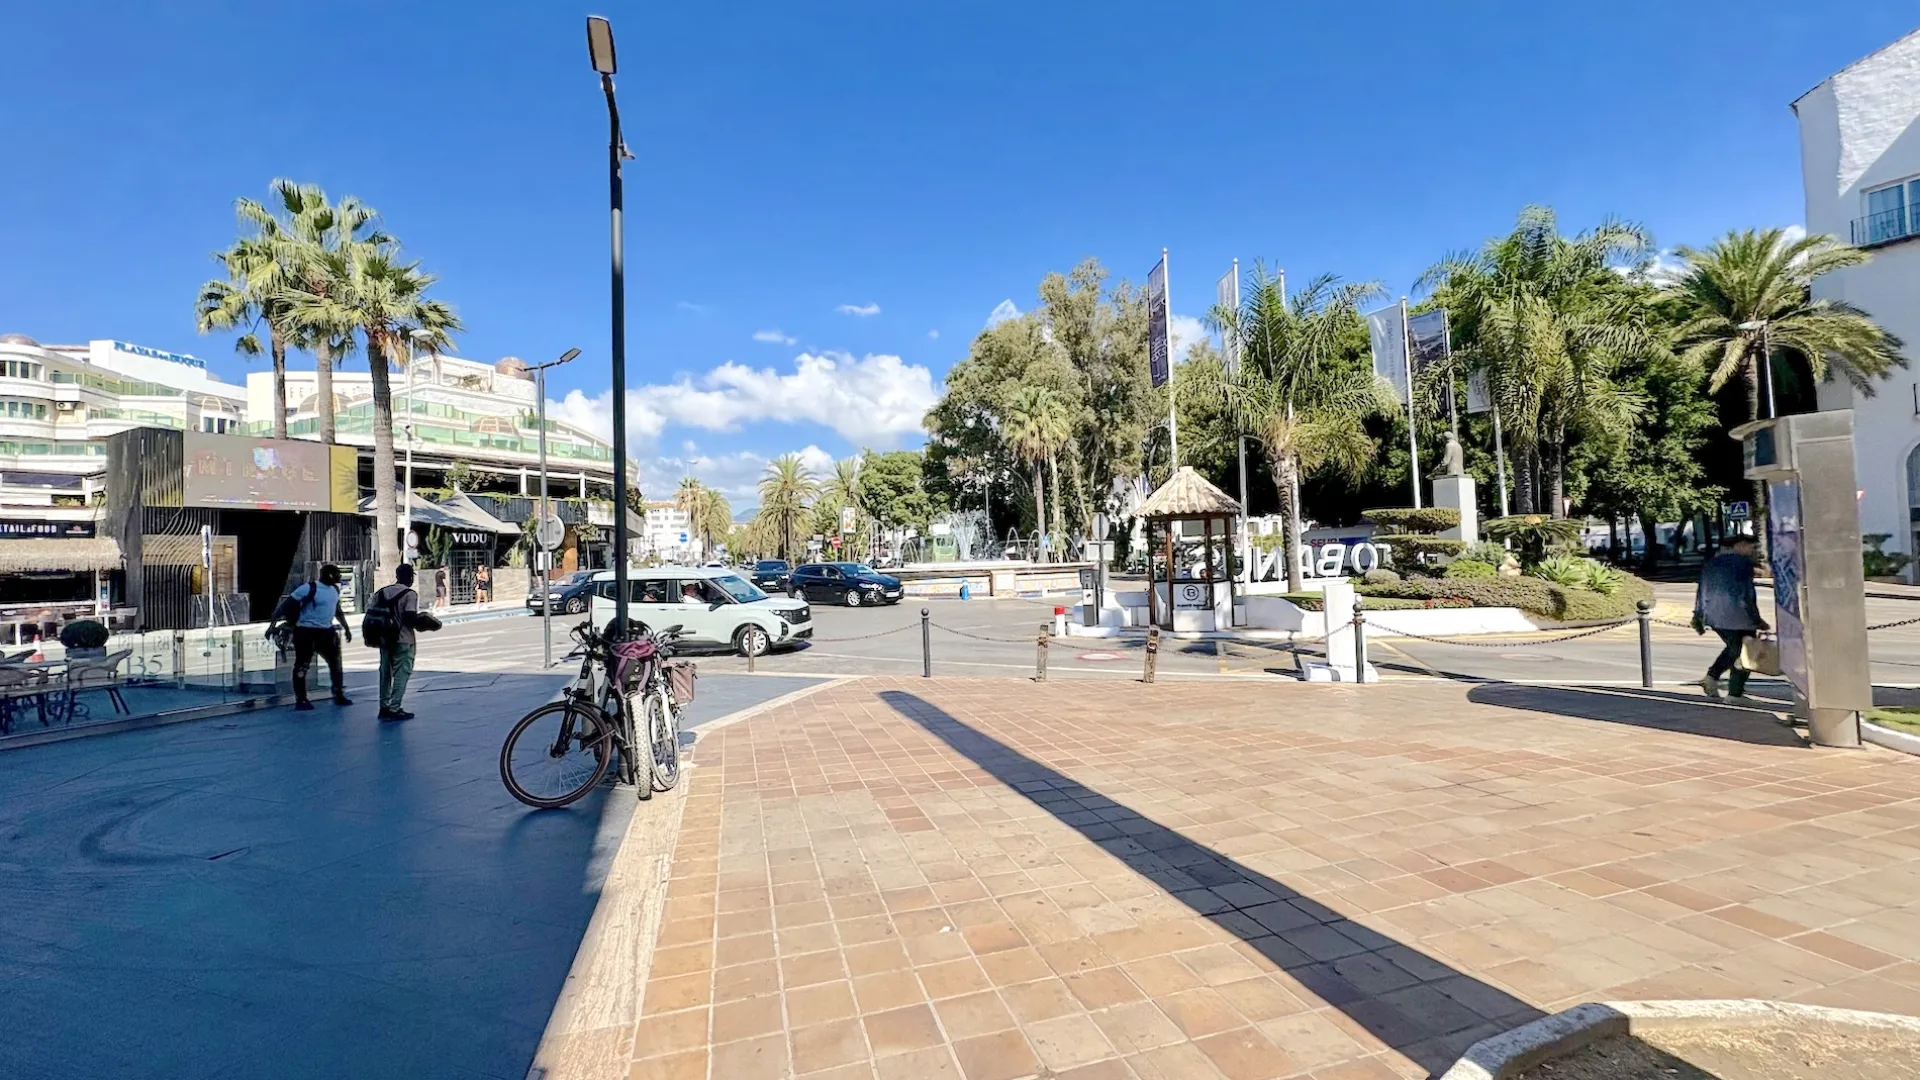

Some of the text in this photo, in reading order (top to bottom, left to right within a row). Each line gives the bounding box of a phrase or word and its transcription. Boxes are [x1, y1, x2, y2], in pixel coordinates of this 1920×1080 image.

[114, 341, 159, 359] PLAYAS
[169, 353, 206, 369] DUQUE
[452, 532, 488, 544] VUDU
